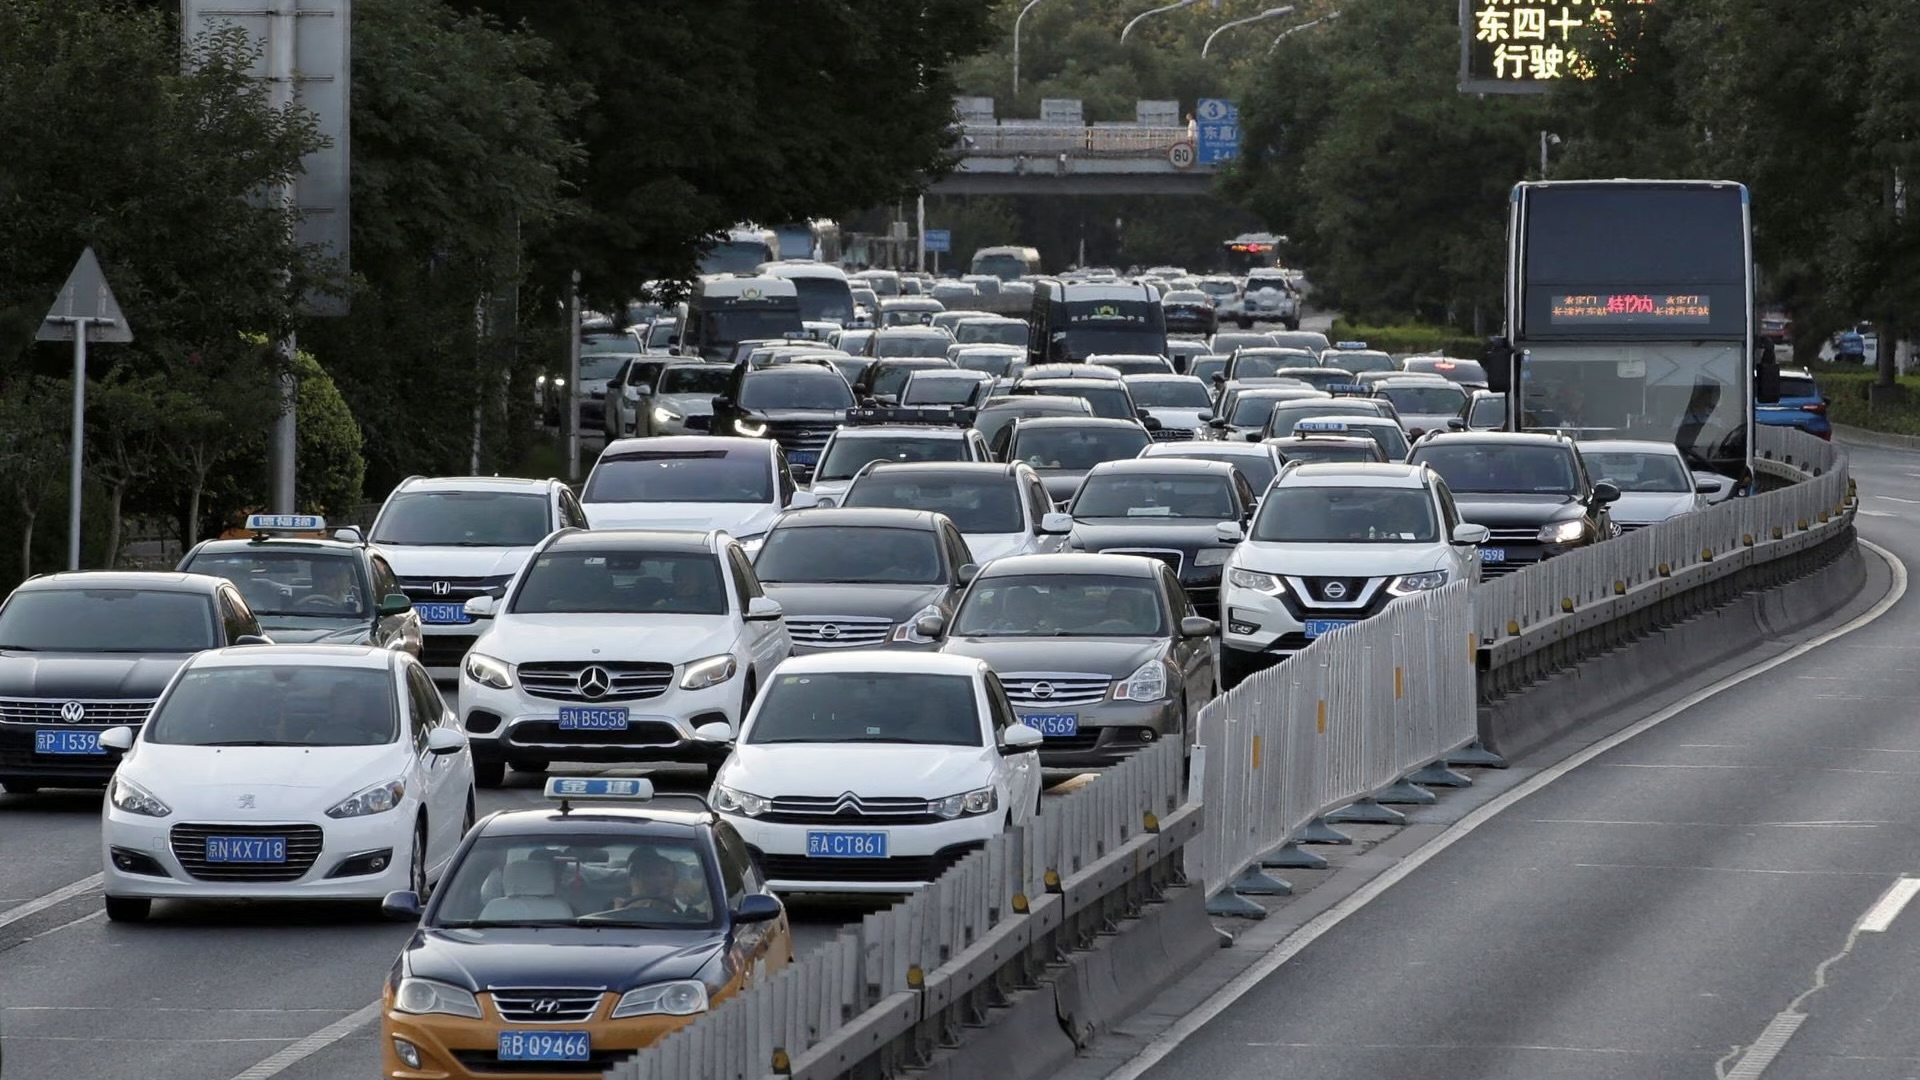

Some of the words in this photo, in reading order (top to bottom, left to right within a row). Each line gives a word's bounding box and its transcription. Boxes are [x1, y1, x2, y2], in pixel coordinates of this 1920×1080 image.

[1476, 6, 1616, 41] 东四十
[1493, 43, 1604, 78] 行驶
[1208, 103, 1218, 117] 3
